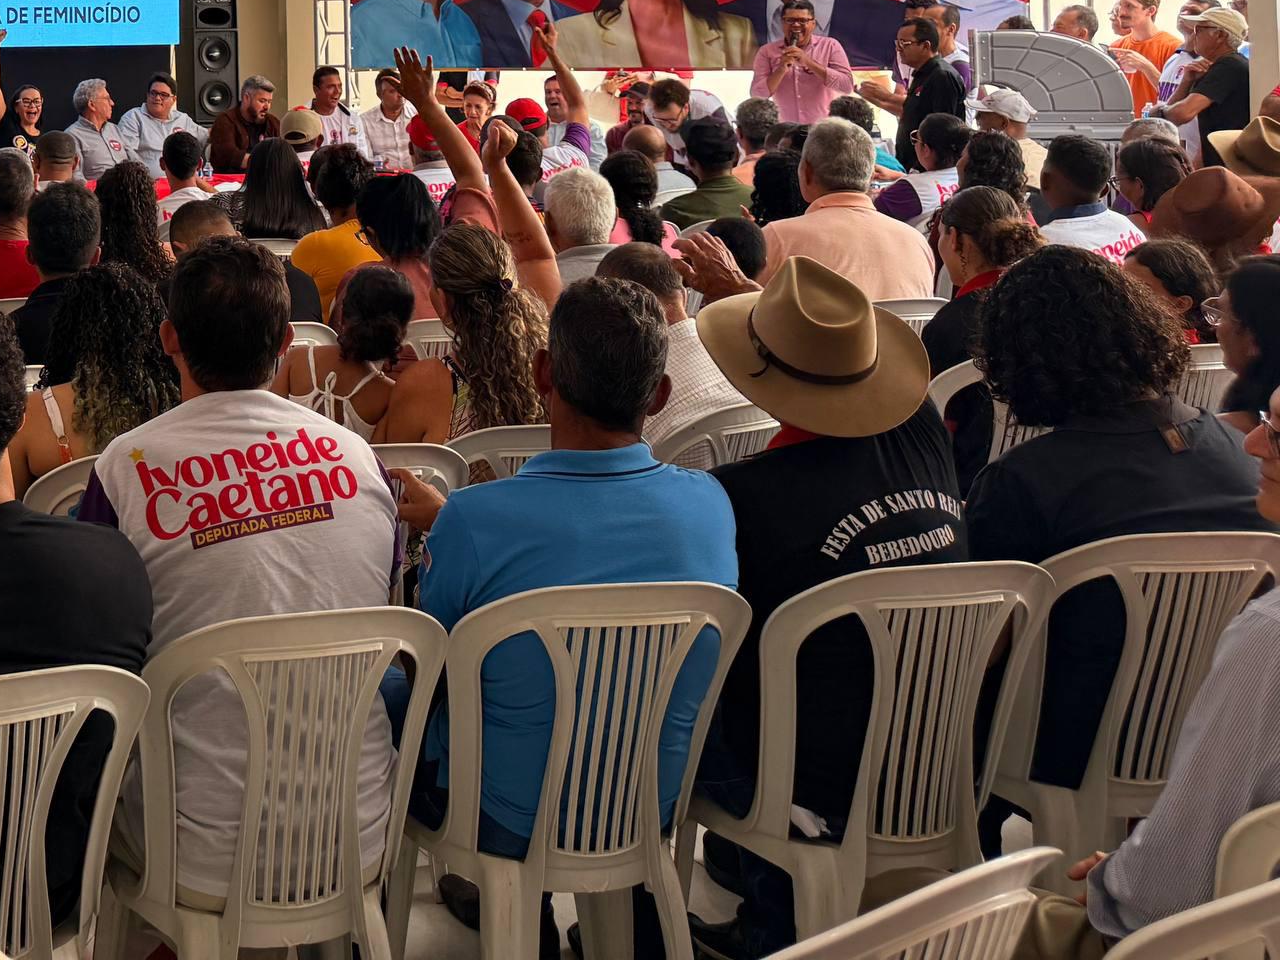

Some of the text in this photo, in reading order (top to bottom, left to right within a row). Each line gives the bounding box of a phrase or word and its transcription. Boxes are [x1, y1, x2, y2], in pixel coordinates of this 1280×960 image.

[6, 6, 29, 24] DE
[33, 1, 141, 25] FEMINICÍDIO
[134, 427, 344, 497] Ivoneide
[145, 464, 358, 541] Caetano
[194, 507, 330, 547] DEPUTADA FEDERAL
[820, 513, 866, 561] FESTA
[859, 498, 887, 525] DE
[884, 488, 935, 515] SANTO
[864, 523, 956, 565] BEBEDOURO
